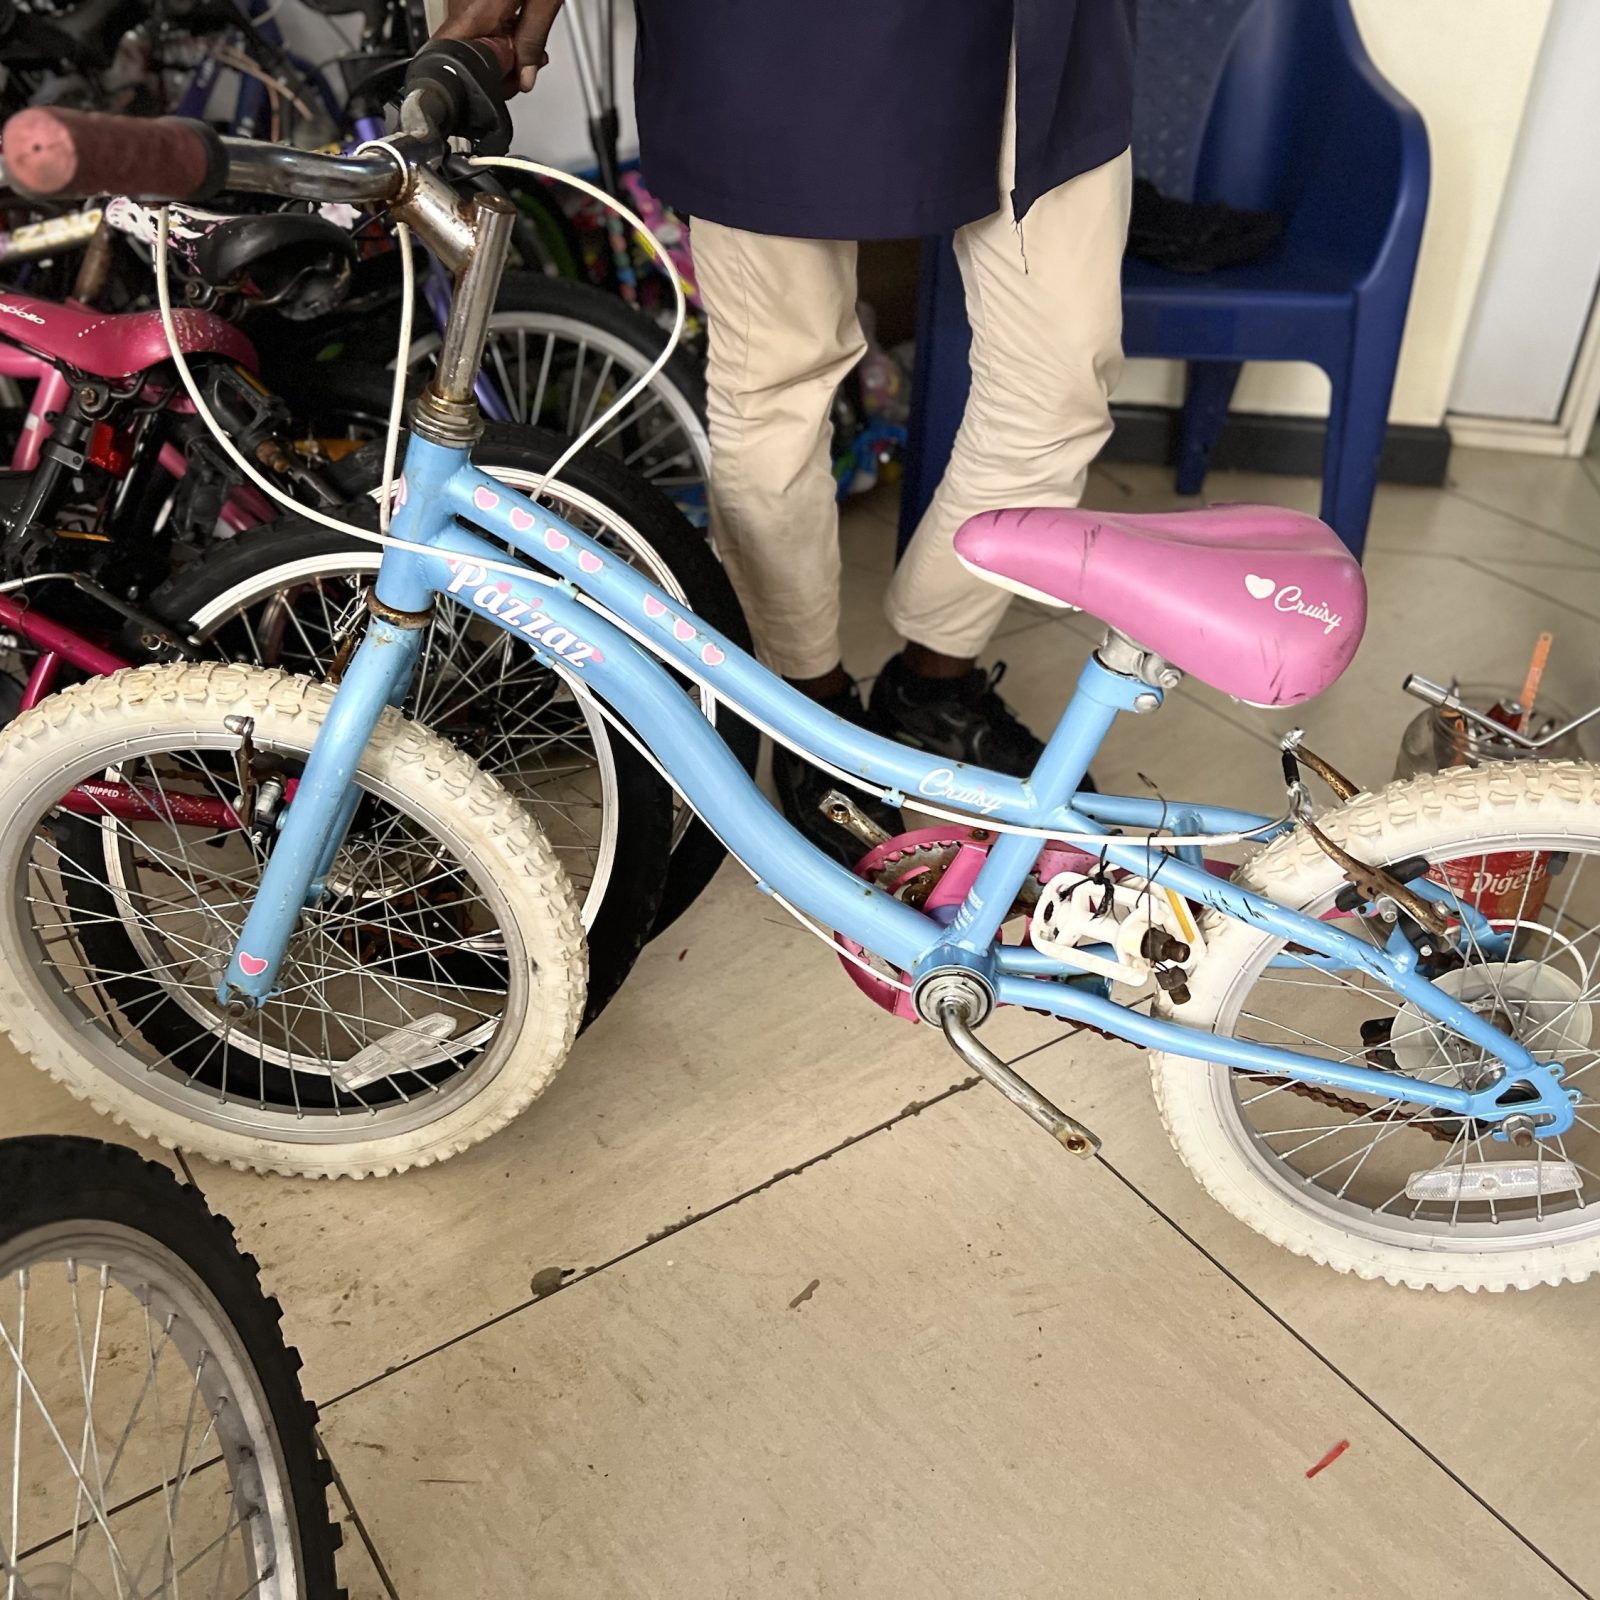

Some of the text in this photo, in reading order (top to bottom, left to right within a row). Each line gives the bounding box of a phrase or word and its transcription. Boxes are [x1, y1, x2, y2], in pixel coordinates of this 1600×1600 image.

[447, 560, 600, 668] Pazzaz
[1274, 585, 1342, 635] Cruisy
[77, 785, 119, 798] UIPPED
[919, 768, 1002, 814] Cruisy
